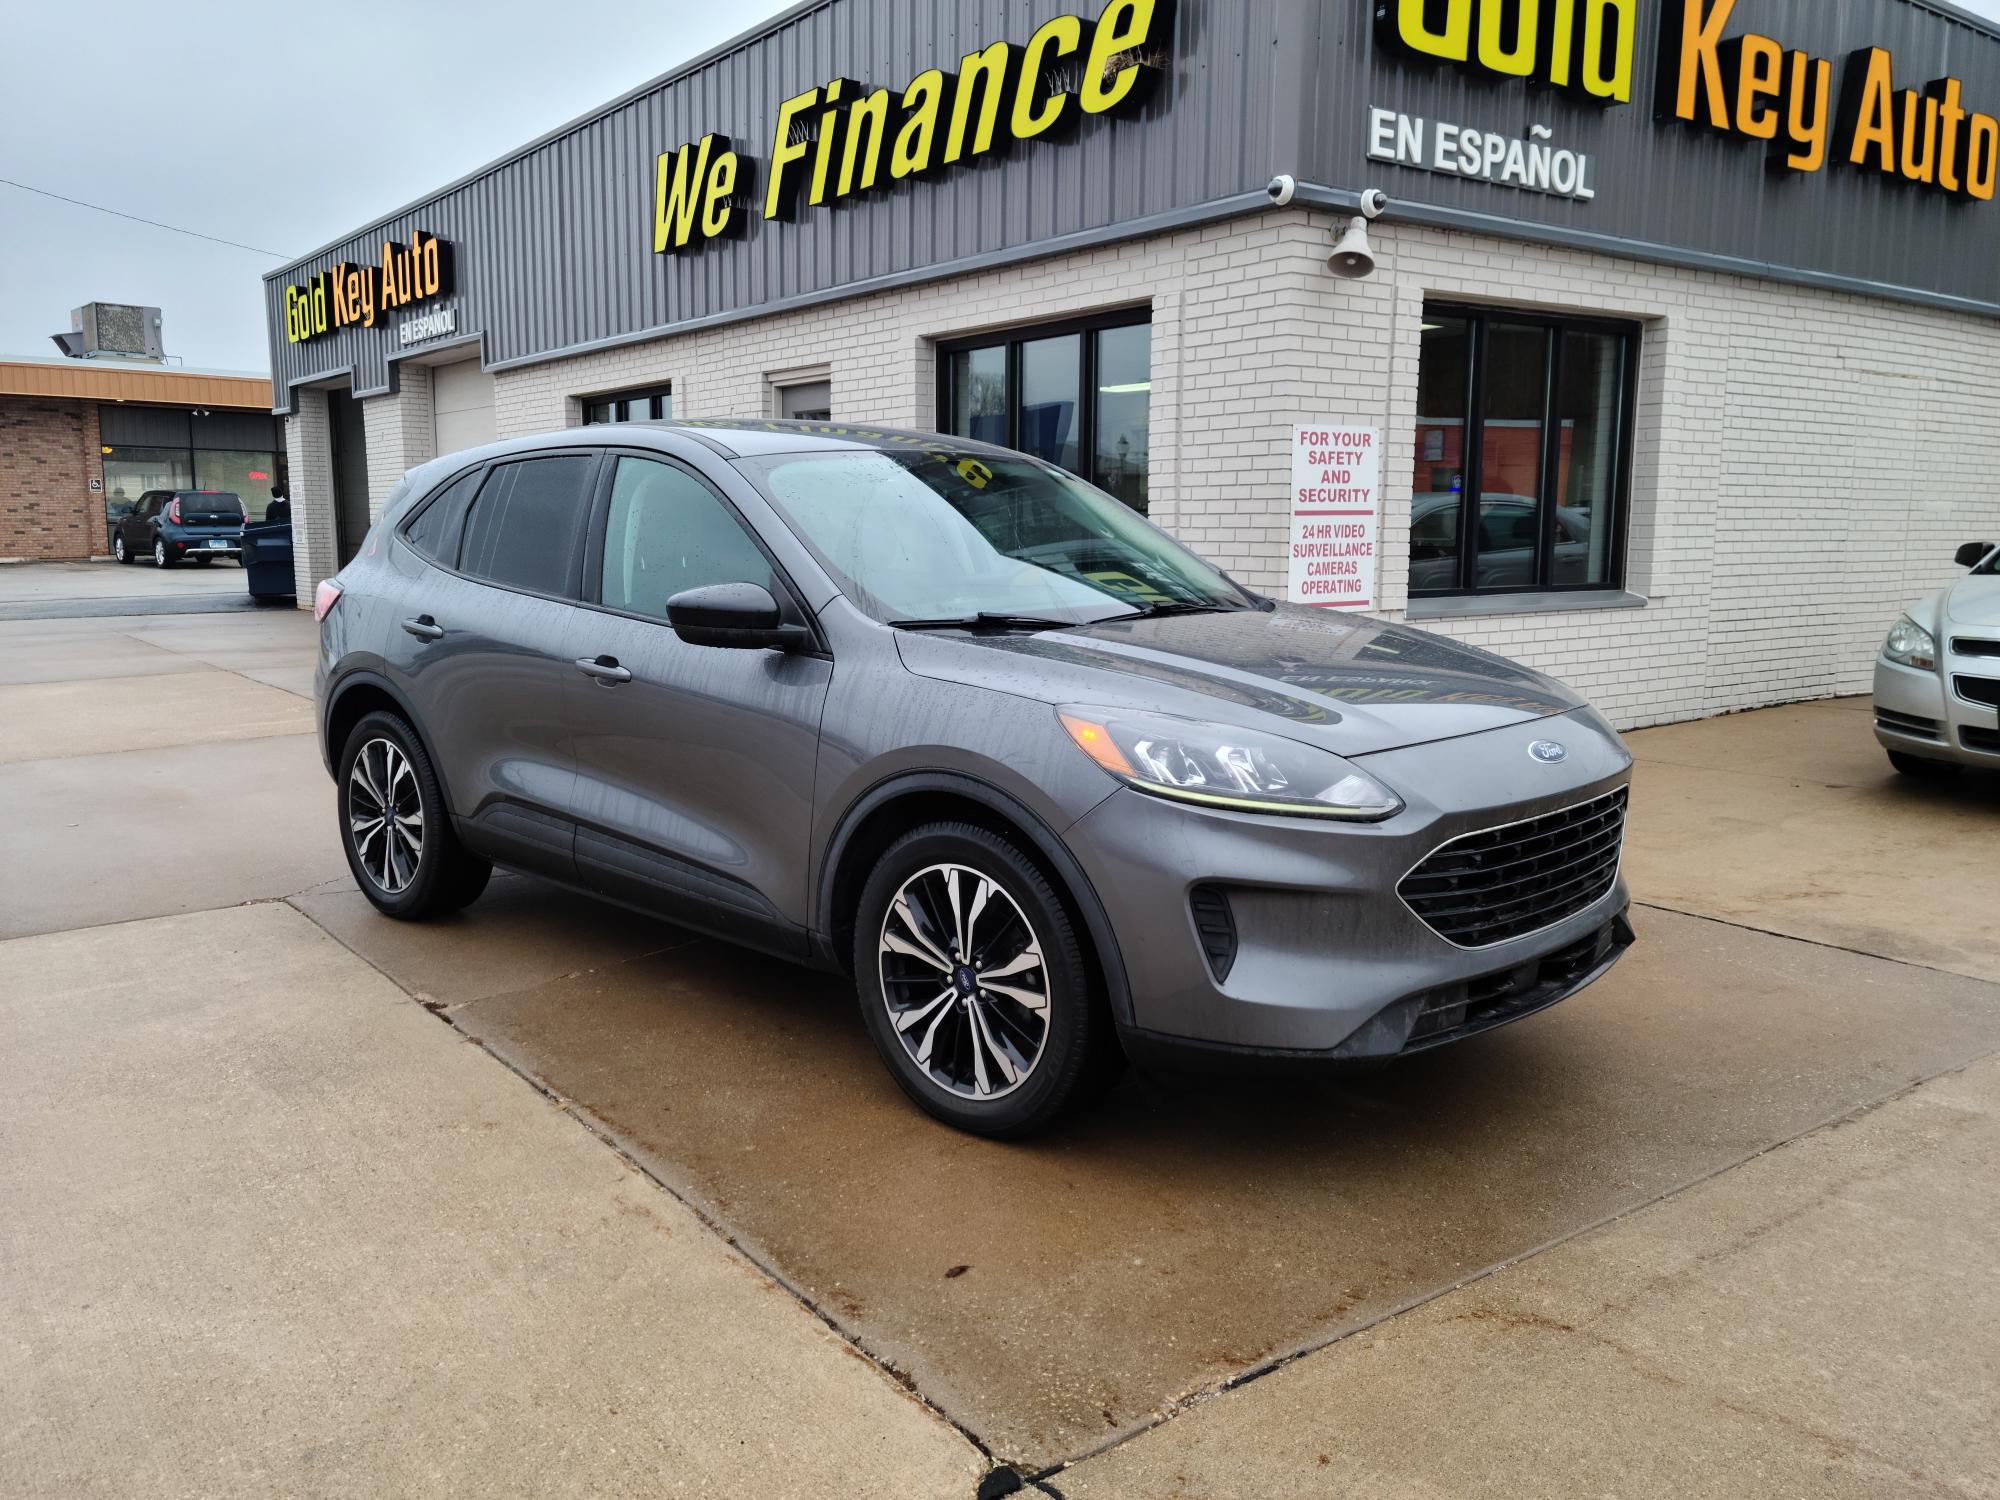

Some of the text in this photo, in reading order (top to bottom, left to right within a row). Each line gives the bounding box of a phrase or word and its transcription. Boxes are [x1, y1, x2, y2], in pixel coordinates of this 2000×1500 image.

[1676, 0, 1832, 173] Key
[1849, 46, 2000, 201] Auto
[653, 0, 1157, 254] We Finance
[1370, 108, 1595, 199] EN ESPAÑOL
[286, 229, 439, 344] Gold Key Auto
[400, 303, 455, 344] EN ESPAÑOL
[1300, 431, 1371, 447] FOR YOUR
[1308, 451, 1363, 466] SAFETY
[1321, 470, 1351, 484] AND
[1298, 488, 1370, 503] SECURITY
[1302, 524, 1365, 539] 24 HR VIDEO
[1293, 542, 1373, 558] SURVEILLANCE
[1307, 560, 1358, 576] CAMERAS
[1301, 579, 1361, 595] OPERATING
[1539, 743, 1563, 758] Ford
